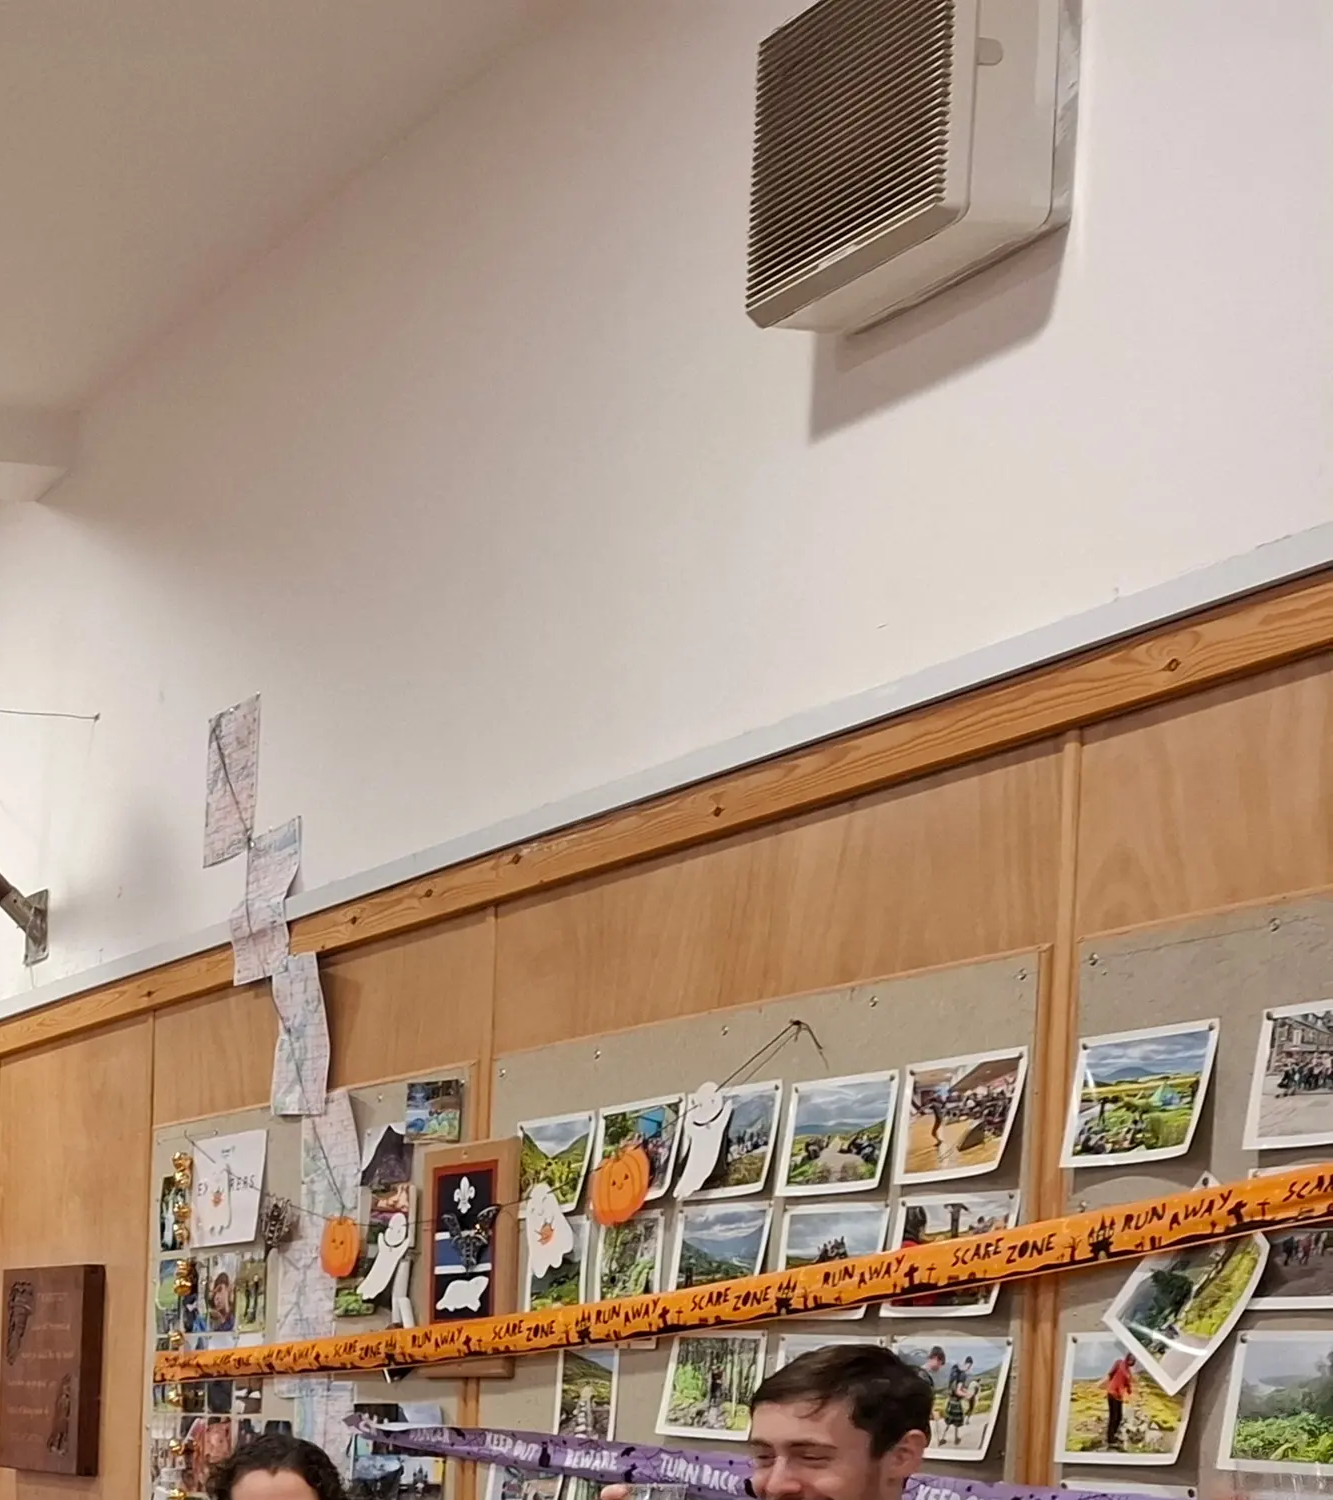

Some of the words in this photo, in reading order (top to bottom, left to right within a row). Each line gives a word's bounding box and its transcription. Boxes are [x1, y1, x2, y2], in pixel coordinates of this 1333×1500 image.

[333, 1339, 359, 1358] SCARE
[358, 1340, 382, 1362] ZONE
[411, 1330, 432, 1349] RUN
[434, 1326, 464, 1352] AWAY
[492, 1319, 524, 1341] SCARE
[525, 1319, 556, 1343] ZONE
[594, 1303, 621, 1326] RUN
[623, 1297, 661, 1327] AWAY
[690, 1286, 731, 1312] SCARE
[732, 1285, 772, 1312] ZONE
[821, 1264, 856, 1288] RUN
[857, 1253, 907, 1289] AWAY
[951, 1237, 1005, 1267] SCARE
[1005, 1232, 1058, 1265] ZONE
[1120, 1203, 1167, 1232] RUN
[1168, 1189, 1234, 1233] AWAY
[484, 1431, 513, 1455] KEEP
[512, 1440, 539, 1462] OUT
[563, 1448, 618, 1472] BEWARE
[660, 1453, 700, 1485] TURN
[701, 1463, 740, 1496] BACK
